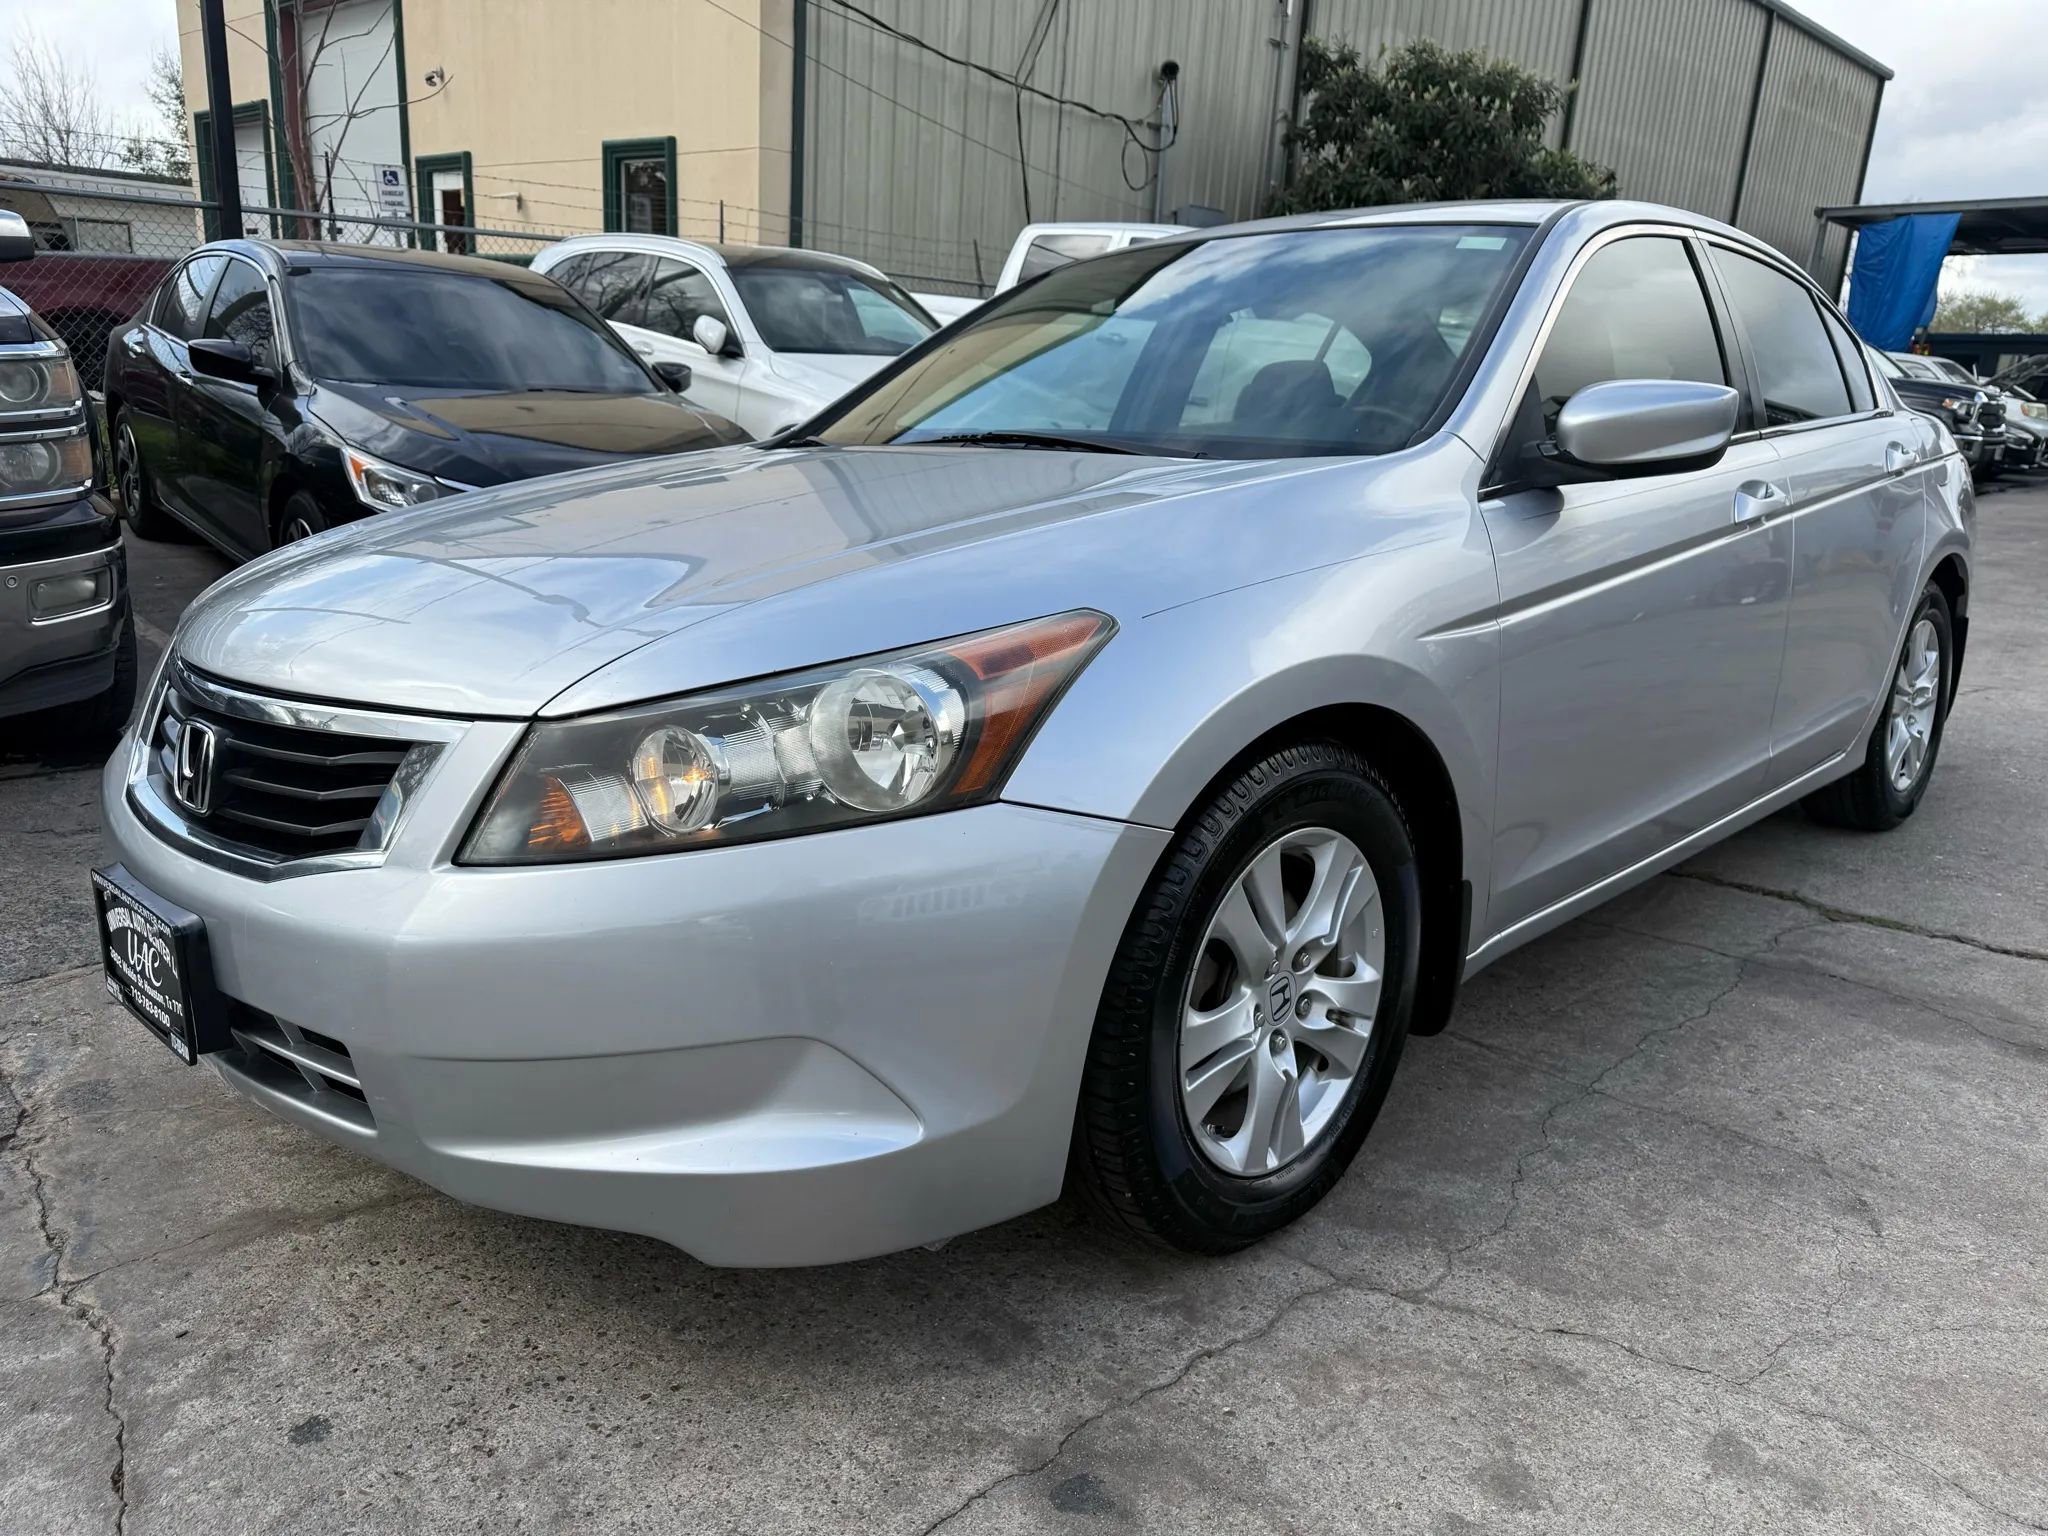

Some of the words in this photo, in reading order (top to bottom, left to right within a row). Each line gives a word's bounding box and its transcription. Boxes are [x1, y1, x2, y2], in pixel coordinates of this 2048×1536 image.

[106, 907, 133, 932] UNIVERSAL
[132, 910, 147, 938] AUTO
[128, 929, 163, 987] UAC
[131, 985, 170, 1027] 713-783-8100
